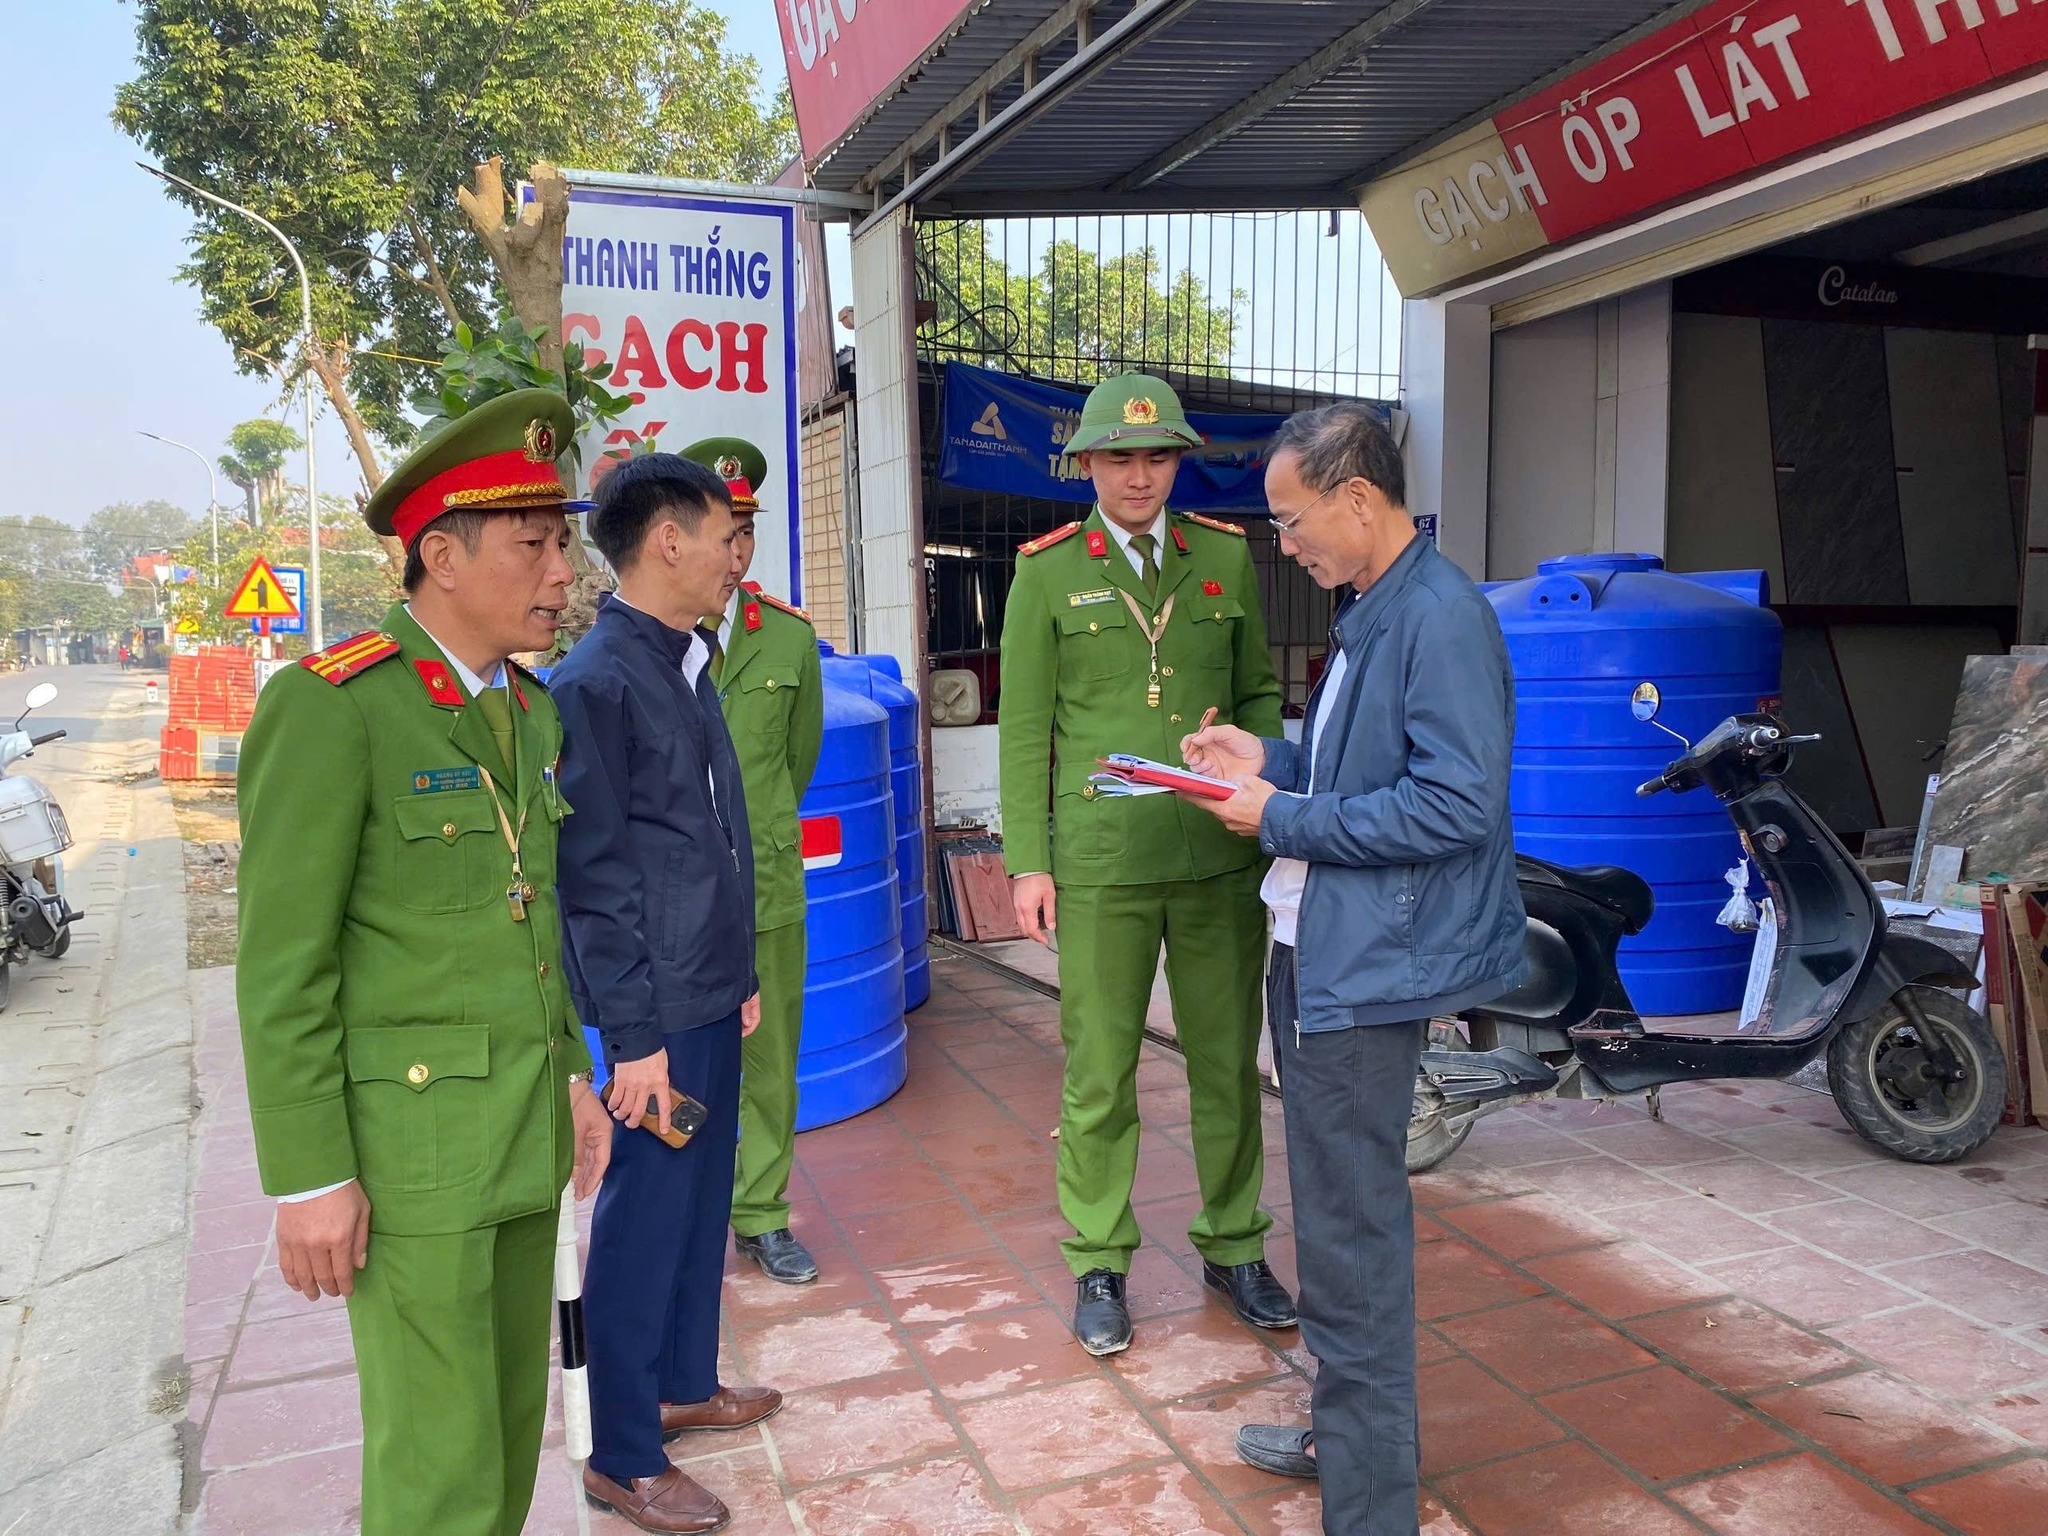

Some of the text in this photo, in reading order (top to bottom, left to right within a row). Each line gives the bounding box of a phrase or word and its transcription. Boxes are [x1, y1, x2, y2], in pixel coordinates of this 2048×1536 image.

[1414, 143, 1549, 251] GẠCH
[1561, 88, 1641, 184] ỐP
[1675, 14, 1811, 139] LÁT
[563, 225, 772, 299] THANH THẮNG
[1818, 265, 1899, 307] Catalan
[1419, 517, 1431, 529] 67
